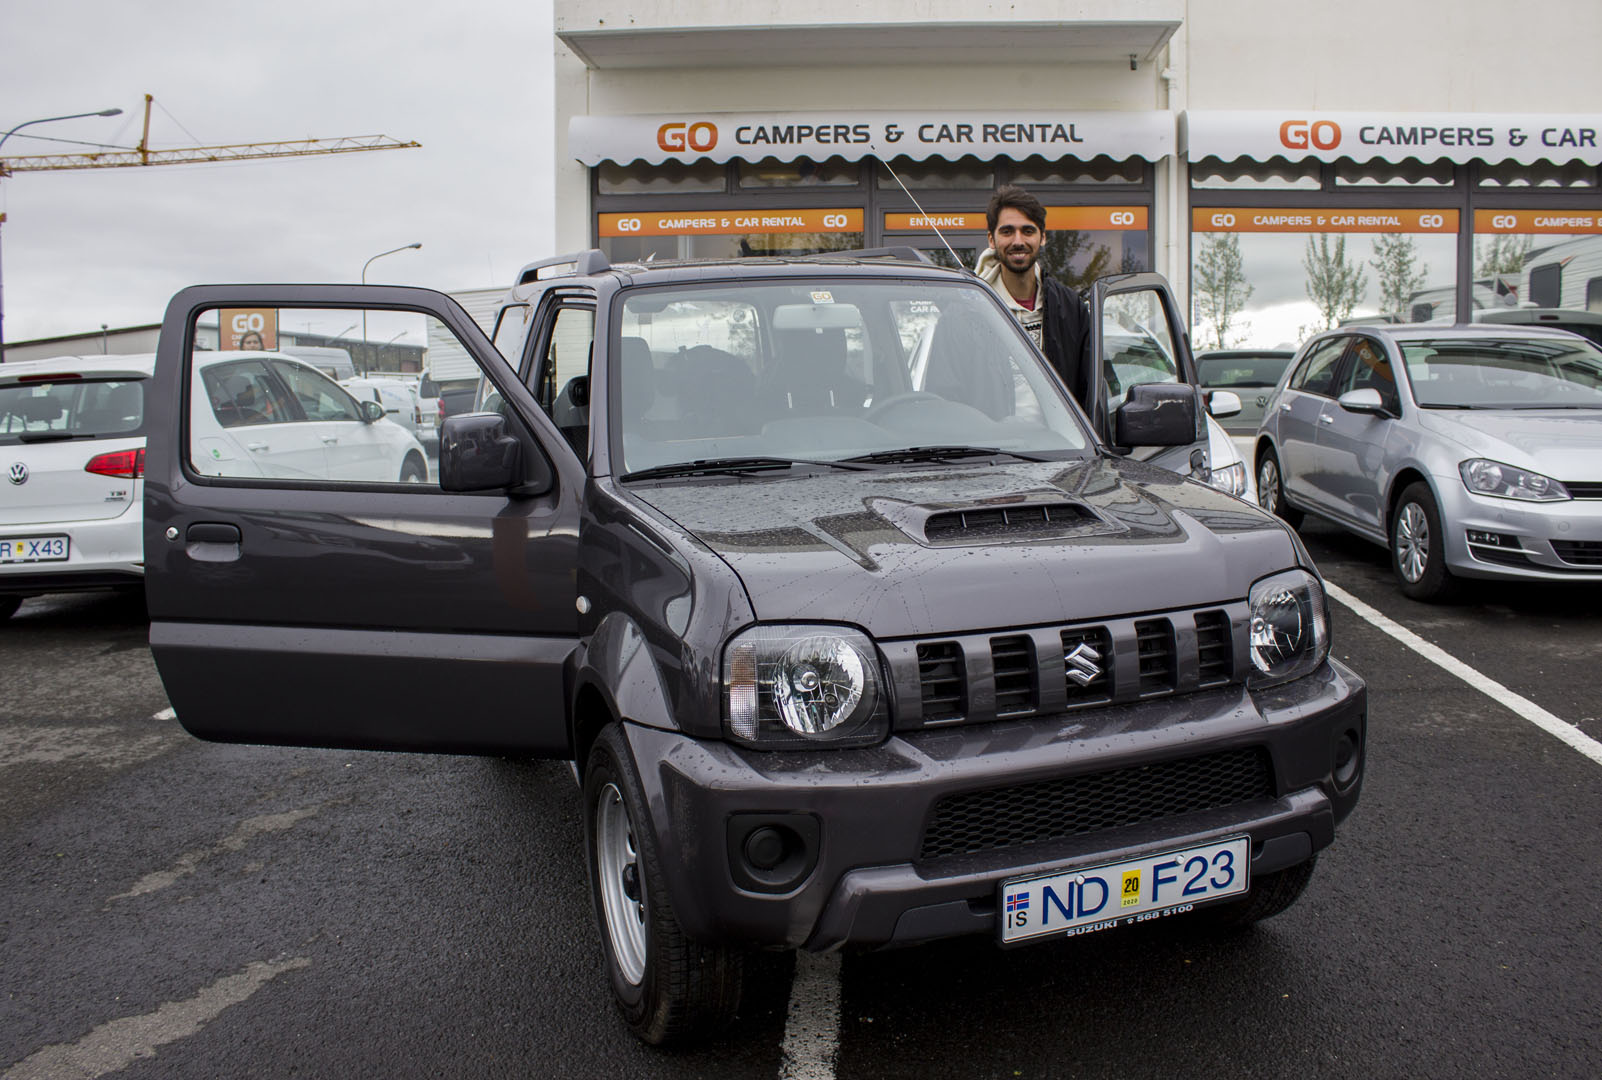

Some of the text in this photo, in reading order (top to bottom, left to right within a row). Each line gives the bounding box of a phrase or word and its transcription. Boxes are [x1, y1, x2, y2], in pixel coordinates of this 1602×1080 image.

[657, 121, 1084, 153] GO CAMPERS & CAR RENTAL
[1279, 120, 1598, 151] GO CAMPERS & CAR
[617, 214, 848, 232] GO CAMPERS & CAR RENTAL GO
[909, 216, 965, 227] ENTRANCE
[1109, 211, 1135, 226] GO
[1210, 213, 1444, 228] GO CAMPERS & CAR RENTAL GO
[1491, 214, 1518, 229] GO
[1533, 216, 1594, 228] CAMPERS
[231, 313, 265, 333] GO
[28, 539, 64, 557] X43
[1041, 849, 1236, 926] ND F23
[1124, 876, 1139, 894] 20
[1008, 911, 1028, 929] IS
[1066, 904, 1194, 937] SUZUKI 568 5100
